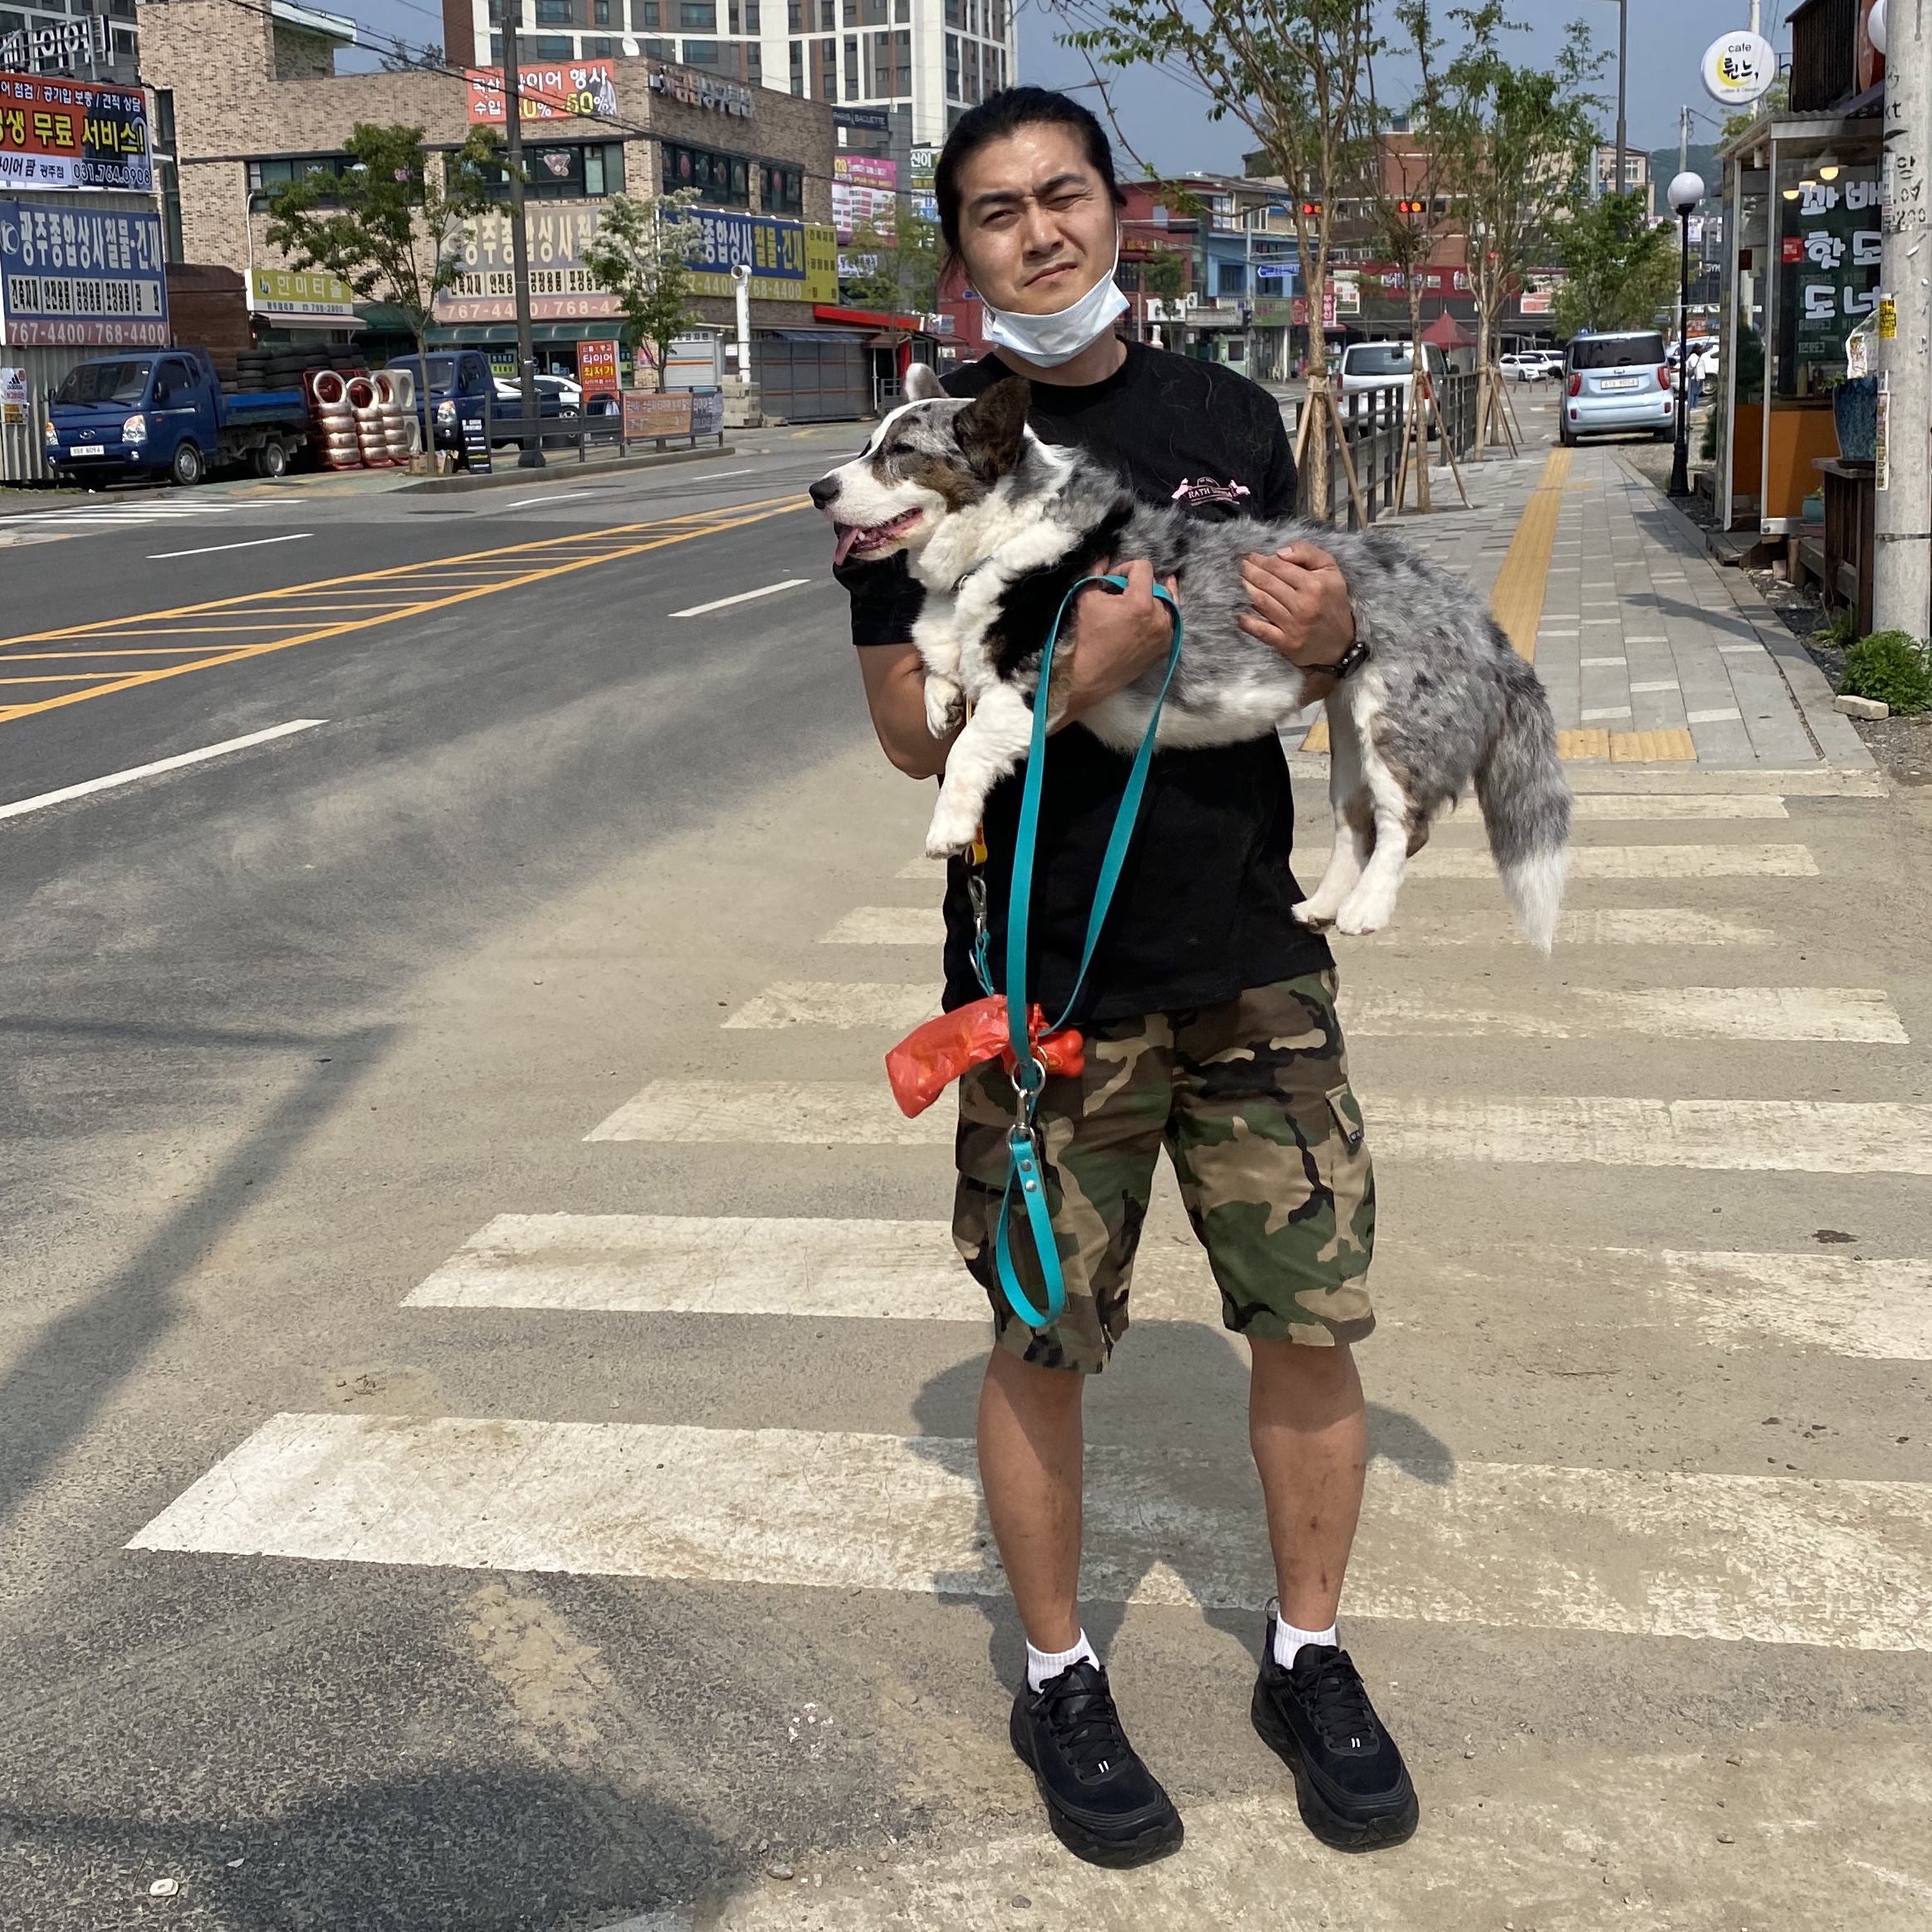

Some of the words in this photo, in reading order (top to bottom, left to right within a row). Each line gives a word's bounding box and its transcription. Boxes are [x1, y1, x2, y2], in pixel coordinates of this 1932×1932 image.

[1729, 42, 1751, 52] cafe
[570, 66, 608, 90] 행사
[14, 83, 33, 99] 점검
[43, 86, 71, 104] 공기압
[103, 94, 120, 111] 견적
[124, 97, 141, 112] 상담
[474, 100, 501, 115] 수입
[34, 113, 75, 146] 무료
[82, 118, 144, 153] 서비스!
[40, 164, 64, 179] 광주점
[73, 163, 150, 184] 031.764.0908
[446, 303, 538, 319] 767-440
[9, 322, 84, 344] 767-4400
[95, 324, 164, 345] 768-4400
[583, 353, 613, 364] 타이어
[584, 365, 614, 377] 최저가
